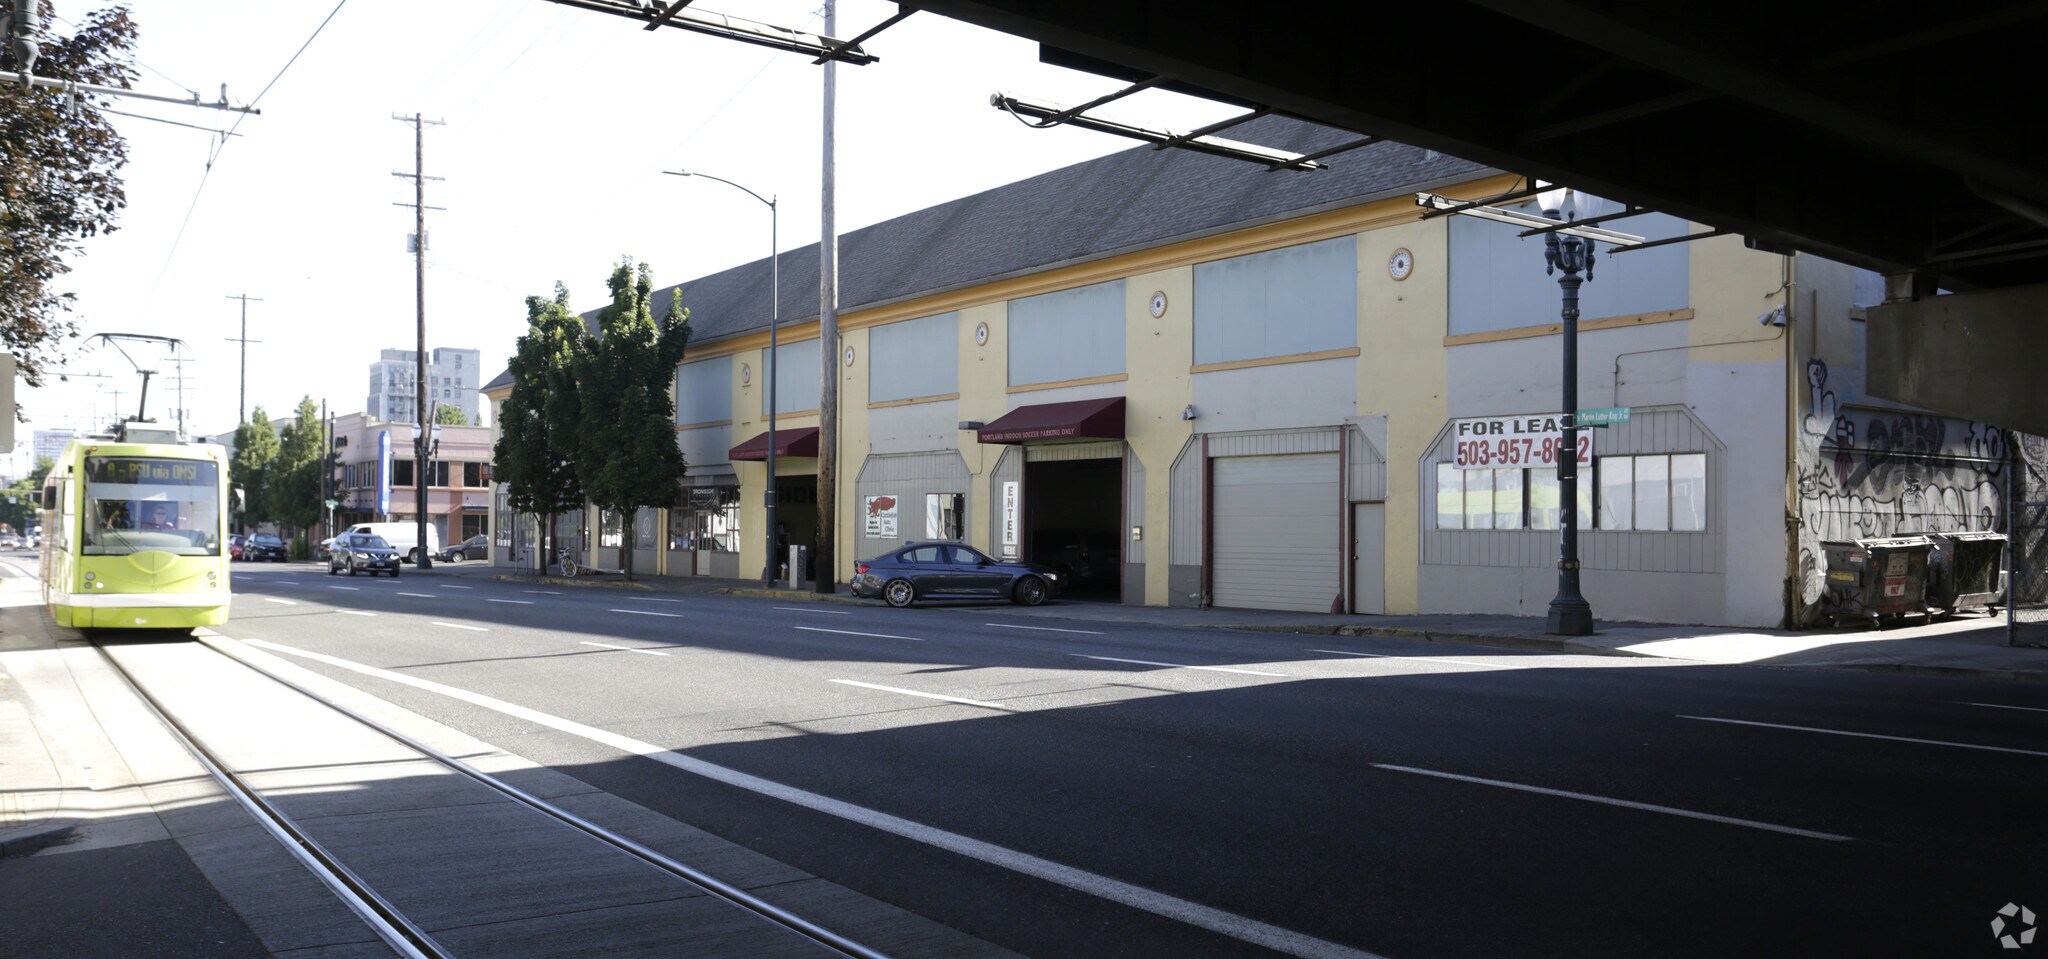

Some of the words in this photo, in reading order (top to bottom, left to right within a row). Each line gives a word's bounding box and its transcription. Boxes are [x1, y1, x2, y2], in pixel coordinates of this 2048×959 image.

[1581, 412, 1595, 421] Martin
[1595, 411, 1608, 421] Luther
[1608, 410, 1618, 422] King
[981, 433, 1003, 441] PORTLAND
[1004, 432, 1022, 440] INDOOR
[1022, 430, 1039, 439] SOCCER
[1040, 429, 1061, 438] PARKING
[1061, 427, 1075, 436] ONLY
[1458, 420, 1504, 436] FOR
[1514, 418, 1590, 433] LEA
[1457, 435, 1590, 467] 503-957-82
[129, 462, 150, 479] PSU
[172, 464, 197, 480] OMSI
